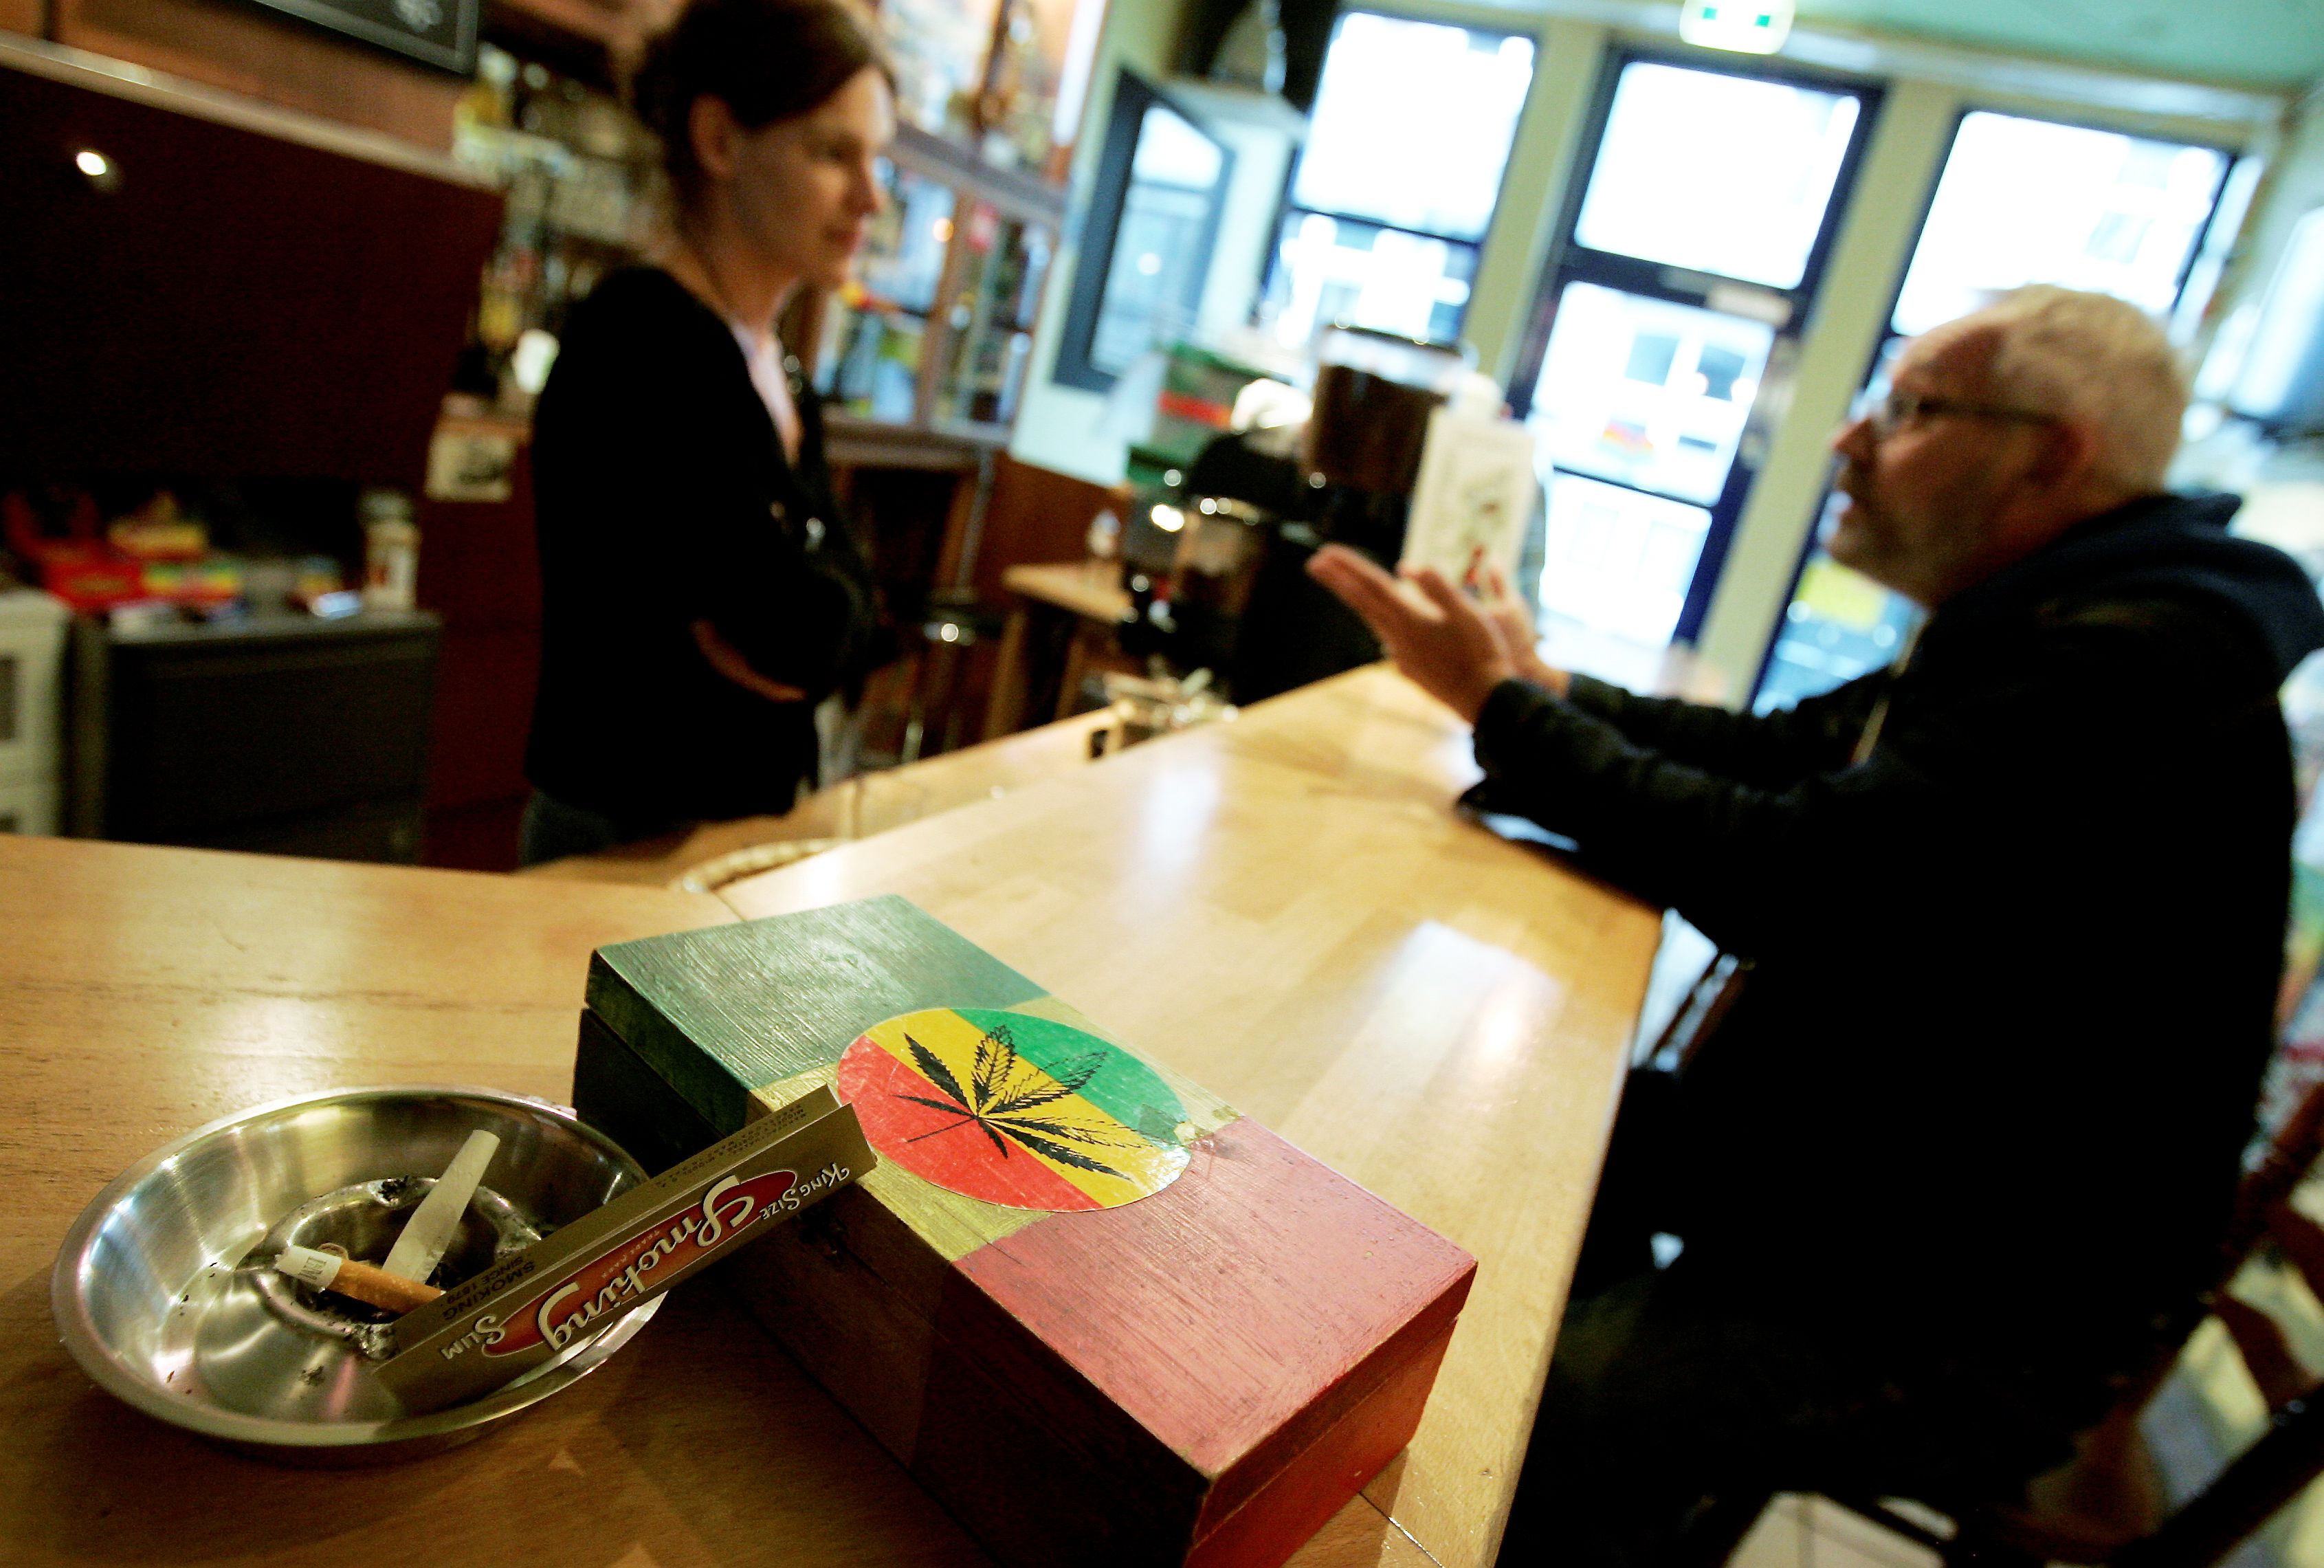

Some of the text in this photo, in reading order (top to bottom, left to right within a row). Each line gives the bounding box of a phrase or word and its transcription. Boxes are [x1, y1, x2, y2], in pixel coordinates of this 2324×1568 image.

[759, 1162, 850, 1219] KING SIZE
[442, 1261, 535, 1320] SMOKING
[482, 1257, 524, 1285] SINCE
[538, 1175, 754, 1350] Smoking
[441, 1314, 505, 1360] SLIM
